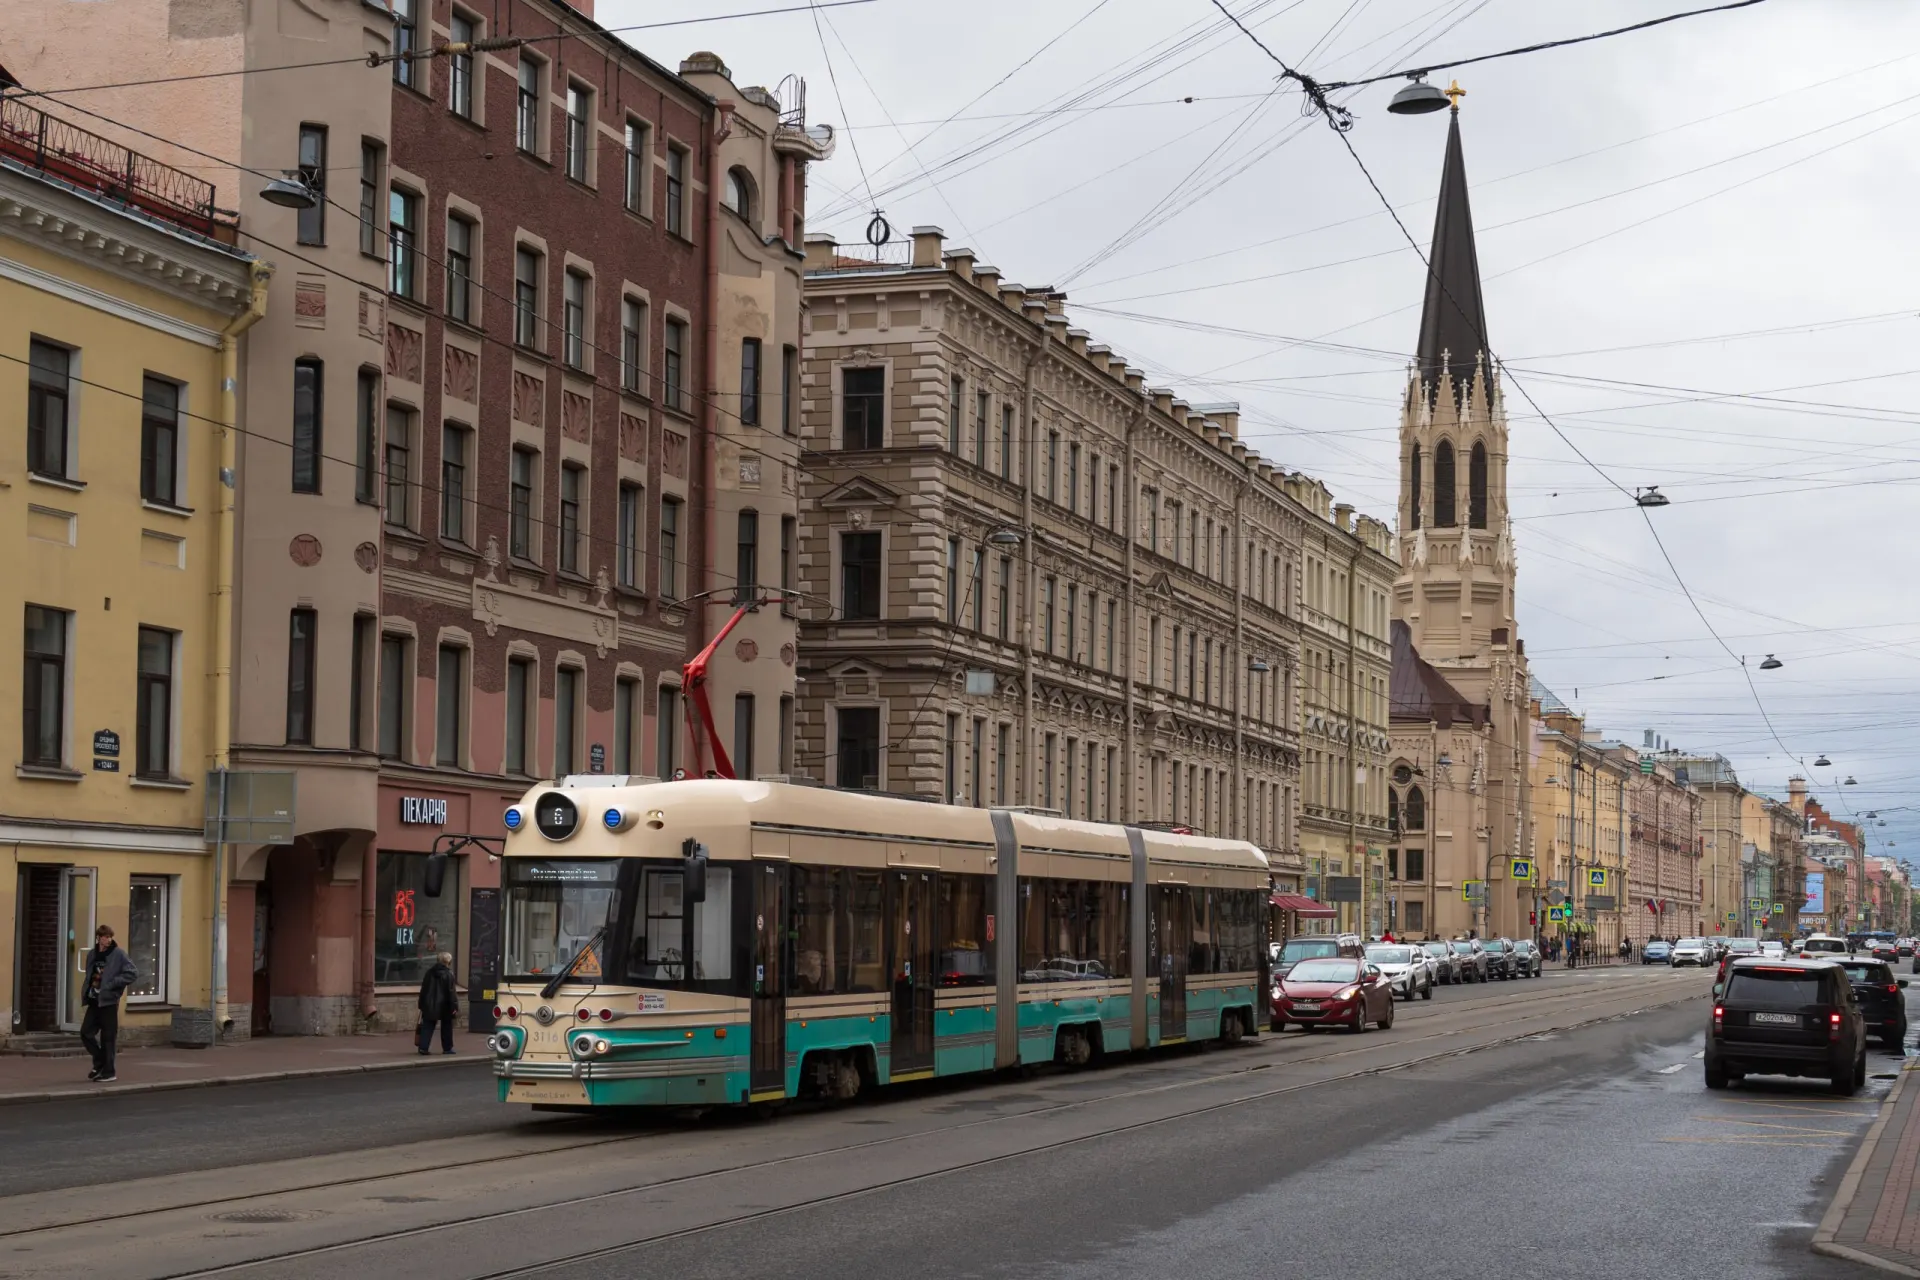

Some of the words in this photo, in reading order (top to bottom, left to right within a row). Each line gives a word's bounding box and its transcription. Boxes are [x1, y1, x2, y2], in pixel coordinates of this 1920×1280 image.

[403, 796, 447, 825] ПЕКАРНЯ
[554, 807, 563, 825] 6
[395, 889, 415, 926] 85
[396, 927, 414, 946] ЦЕХ
[533, 1031, 559, 1043] 3116
